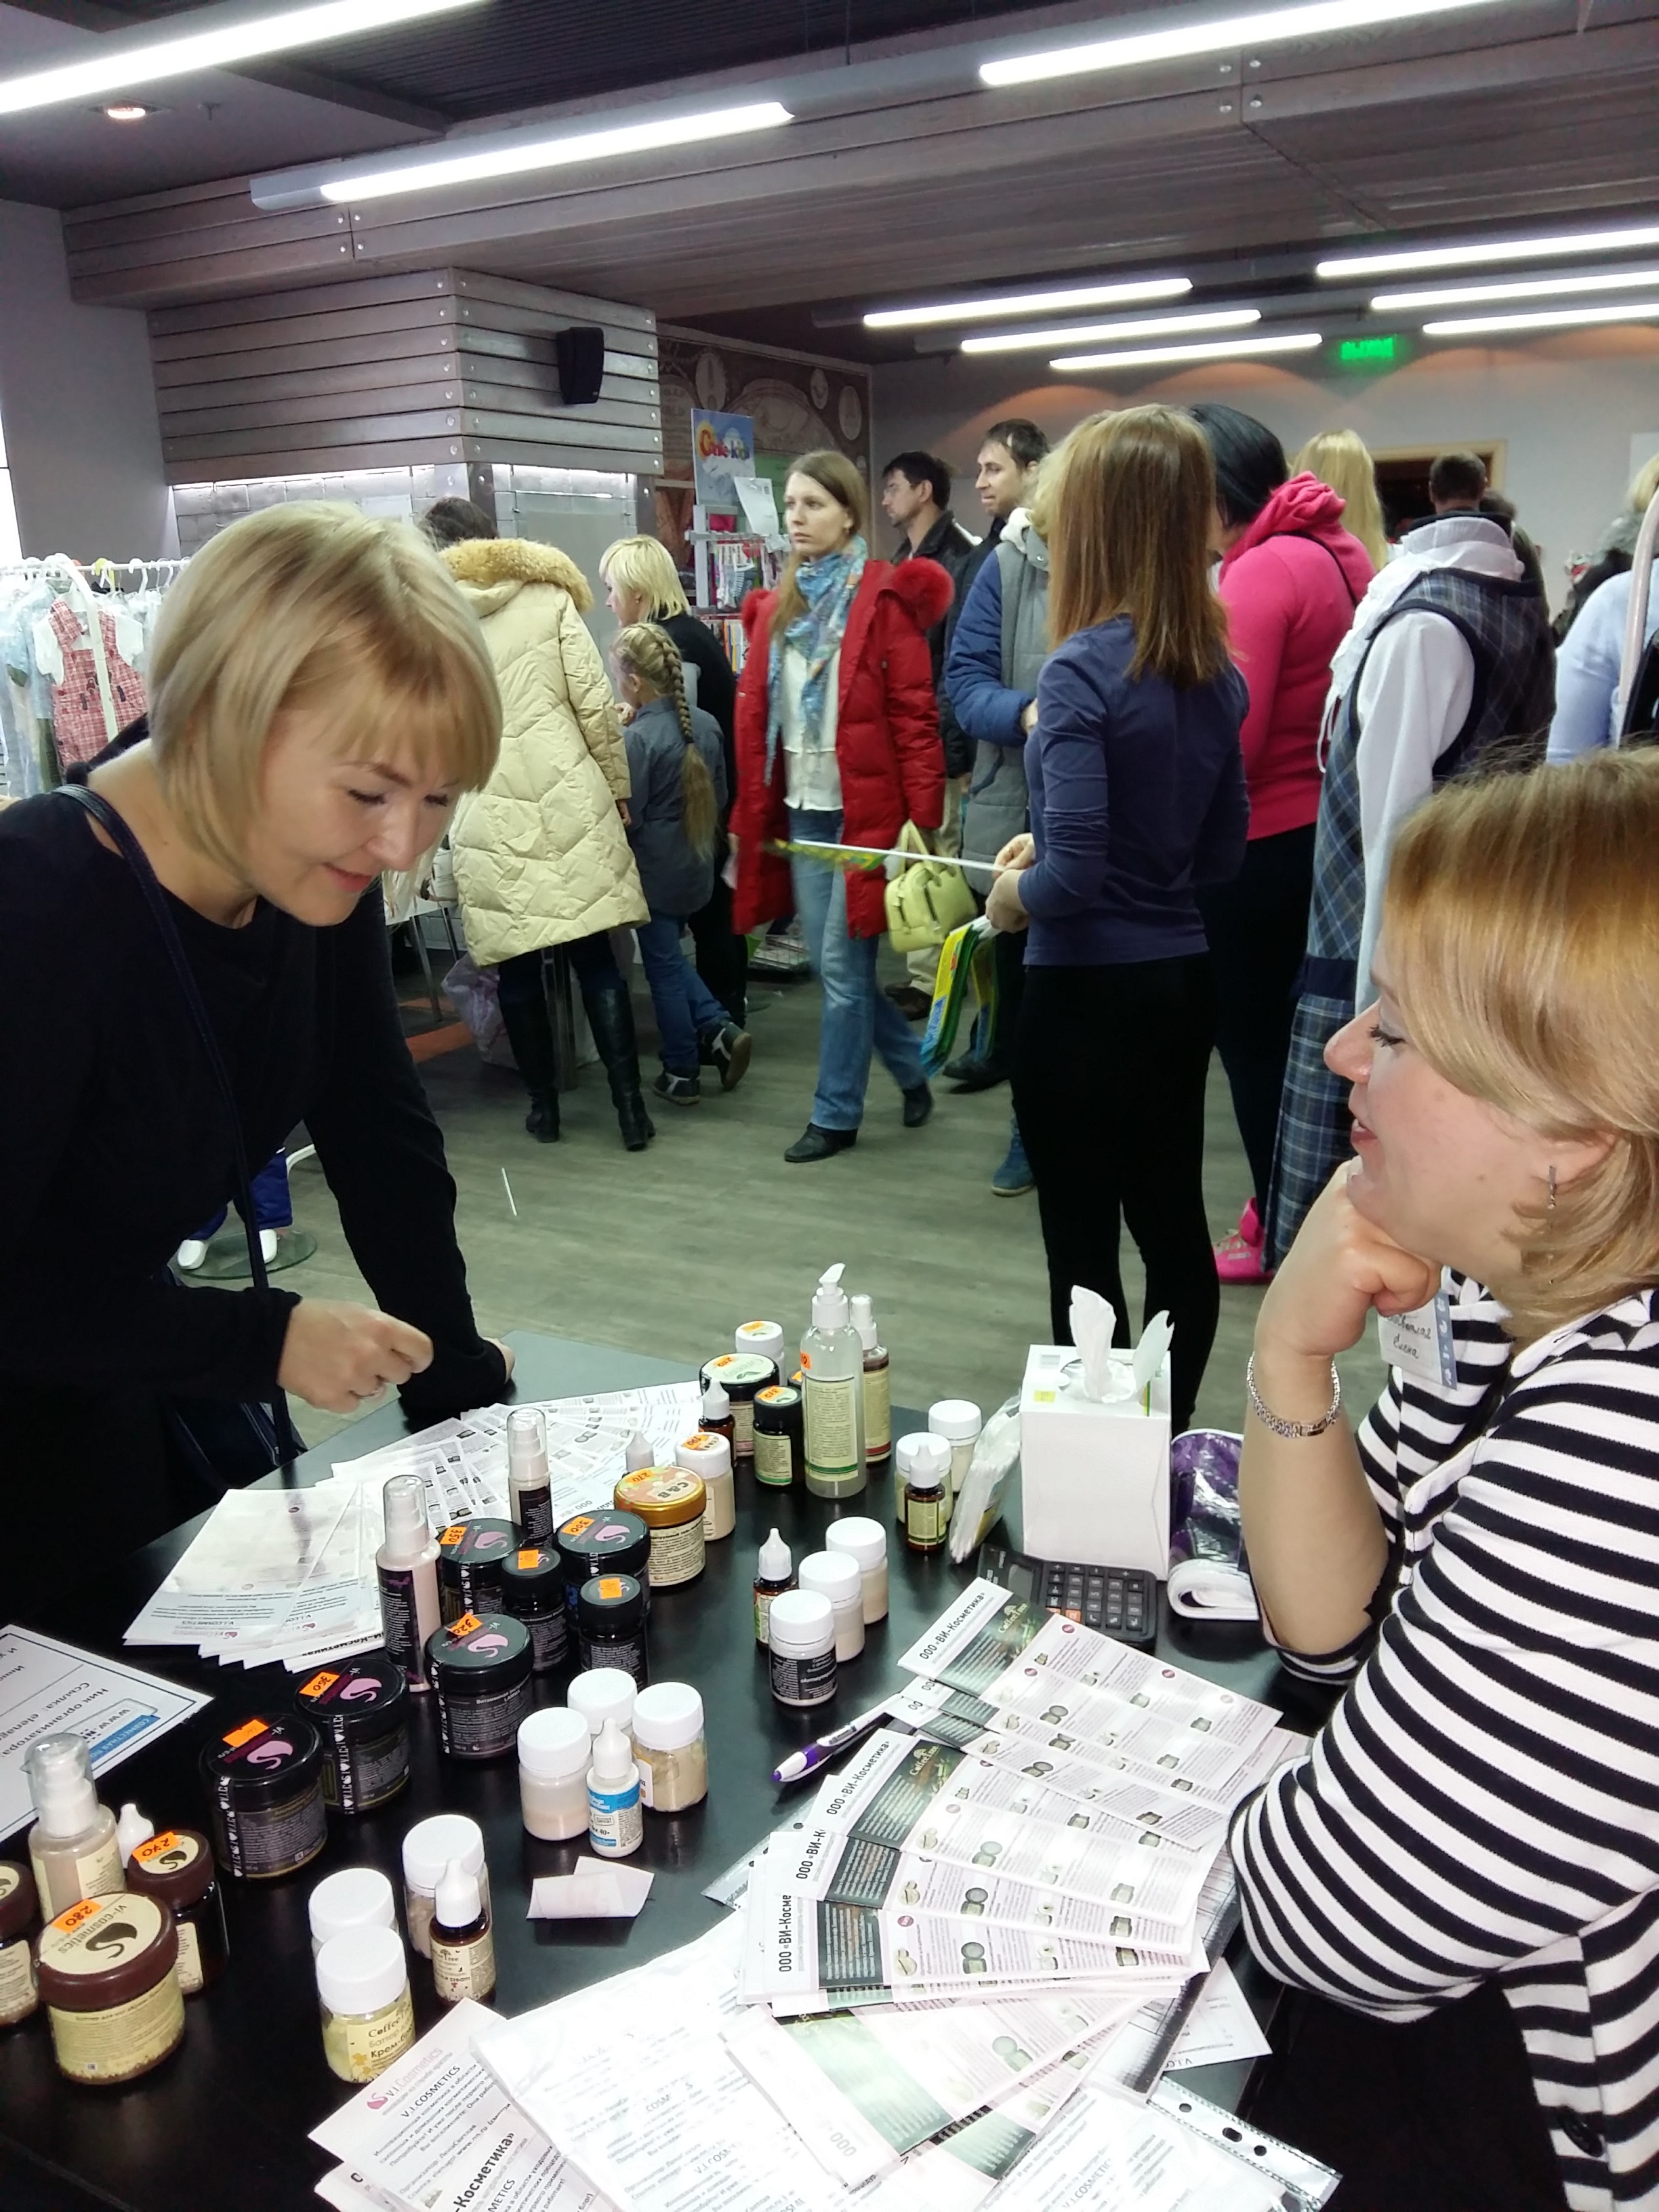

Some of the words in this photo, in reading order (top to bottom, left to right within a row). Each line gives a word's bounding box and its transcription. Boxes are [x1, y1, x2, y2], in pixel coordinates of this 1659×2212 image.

[658, 1482, 689, 1498] C&B
[570, 1519, 589, 1533] 300
[449, 1530, 463, 1543] 350
[454, 1618, 473, 1633] 320
[920, 1644, 937, 1660] ООО
[935, 1593, 985, 1644] «ВИ-Косметика»
[313, 1676, 331, 1691] 360
[41, 1681, 91, 1714] Ссылка:
[83, 1686, 108, 1706] Ник
[827, 1798, 845, 1815] ООО
[841, 1741, 890, 1798] «ВИ-Косметика»
[142, 1837, 170, 1857] 270
[796, 1861, 813, 1879] ООО
[65, 1905, 93, 1927] 280
[779, 1952, 792, 1972] ООО
[401, 2064, 461, 2120] V.I.COSMETICS
[419, 2088, 451, 2116] косметика
[453, 2063, 478, 2085] области
[466, 2096, 480, 2109] Она
[413, 2105, 445, 2135] домашних
[433, 2116, 446, 2129] уже
[445, 2102, 462, 2118] после
